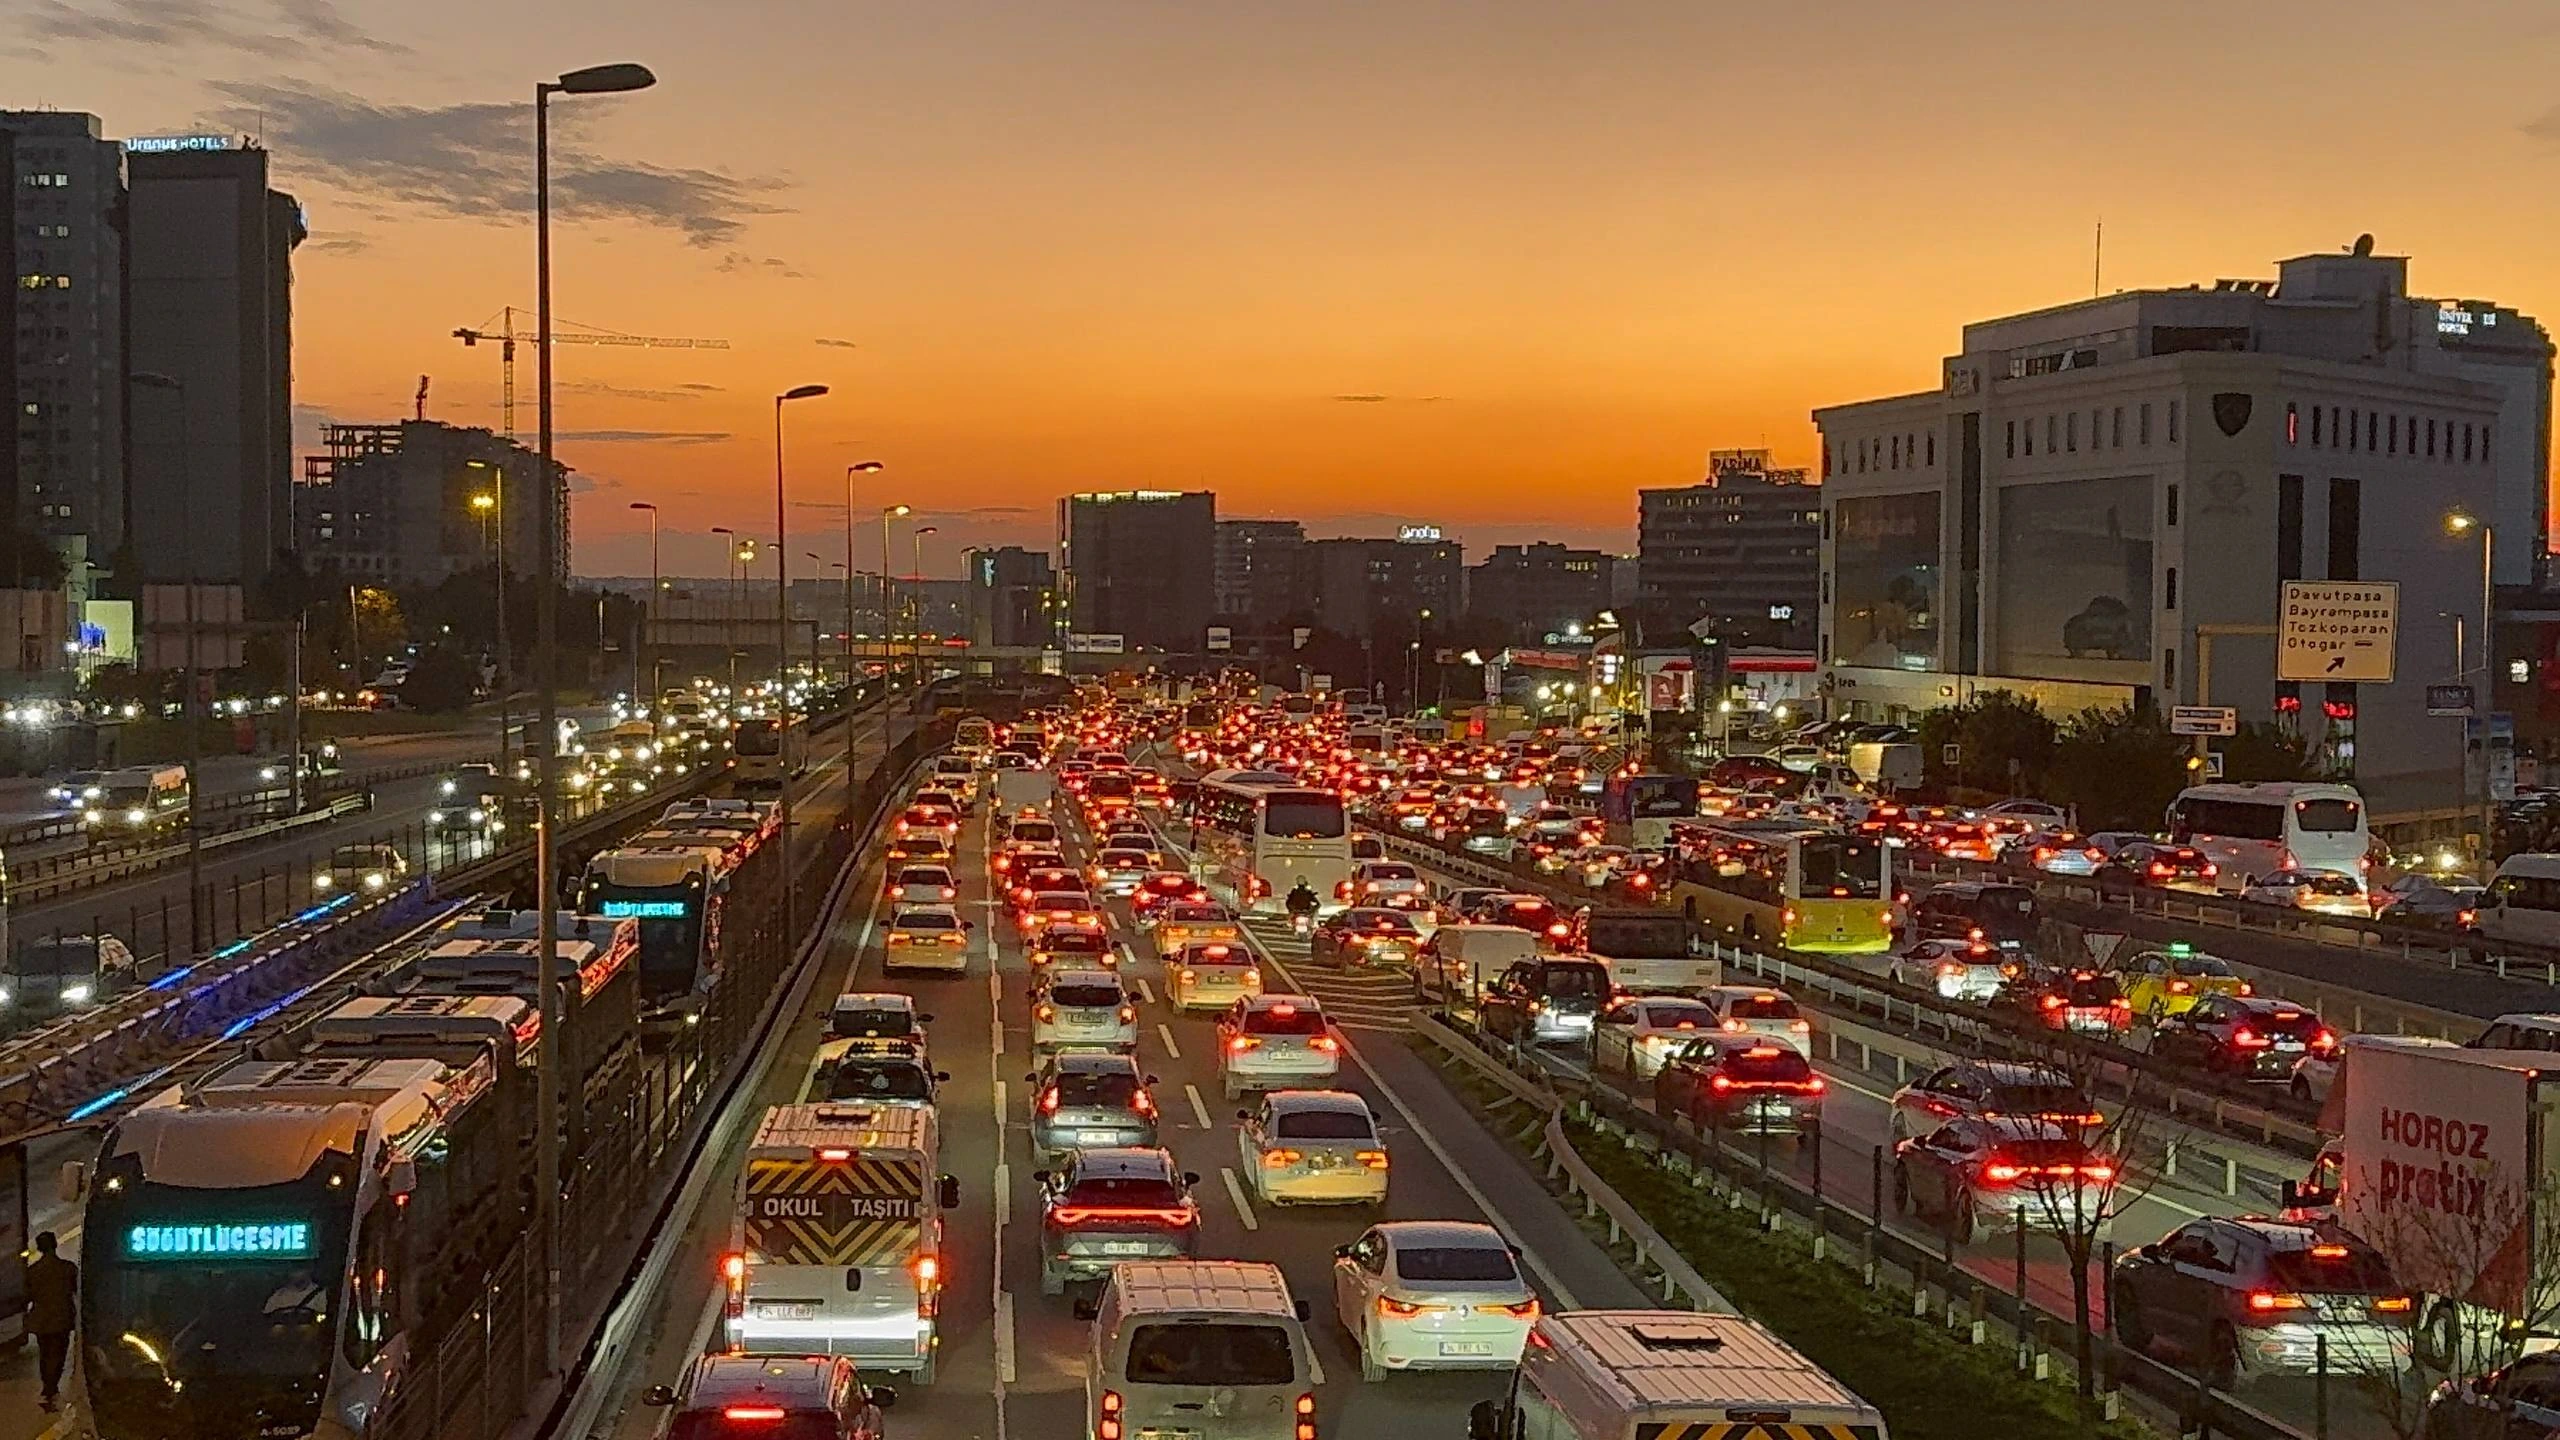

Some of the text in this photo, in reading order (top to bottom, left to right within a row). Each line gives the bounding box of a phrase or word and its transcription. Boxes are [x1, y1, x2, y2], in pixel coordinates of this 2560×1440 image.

[181, 137, 228, 150] HOTELS
[2287, 637, 2346, 652] Otogar
[2381, 1106, 2489, 1159] HOROZ
[763, 1198, 824, 1216] OKUL
